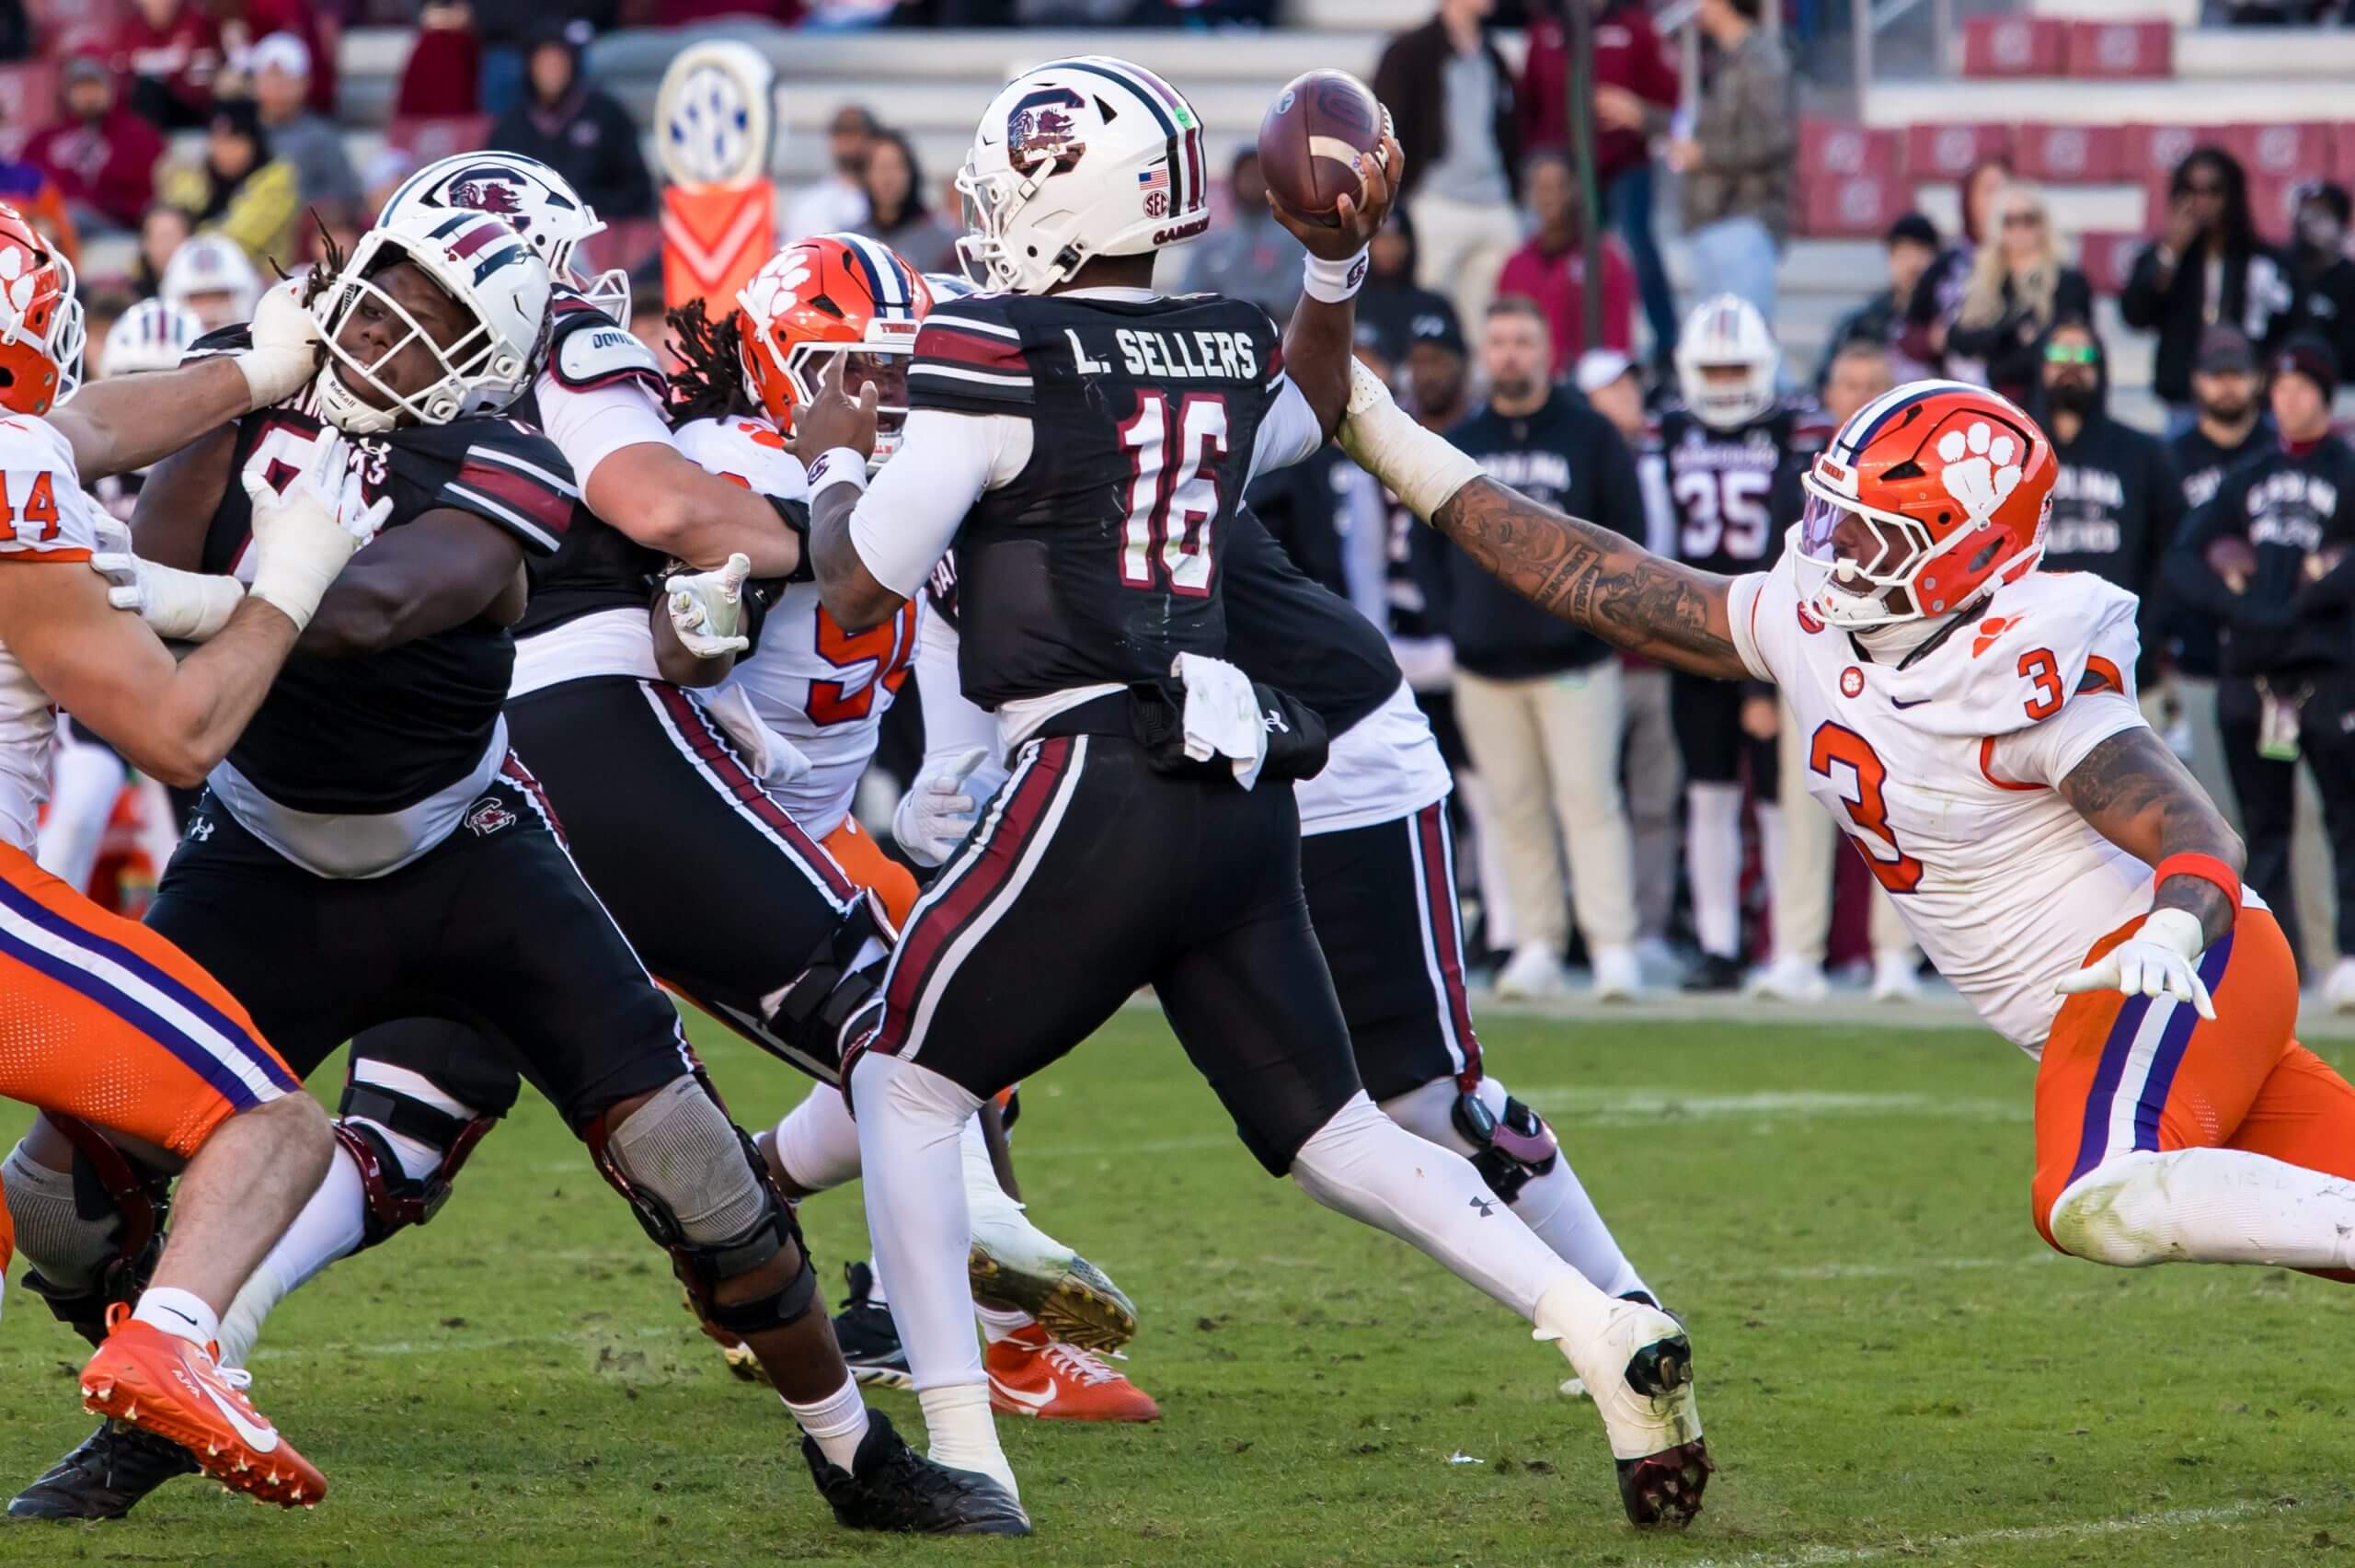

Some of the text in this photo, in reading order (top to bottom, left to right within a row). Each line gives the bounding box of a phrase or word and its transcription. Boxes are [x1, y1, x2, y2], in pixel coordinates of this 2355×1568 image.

[1145, 191, 1168, 217] SEC
[1063, 328, 1258, 380] L. SELLERS
[328, 380, 357, 407] Riddell
[1116, 388, 1231, 598] 16
[1674, 471, 1772, 559] 35
[2017, 647, 2063, 722] 3
[1809, 718, 1924, 895] 3
